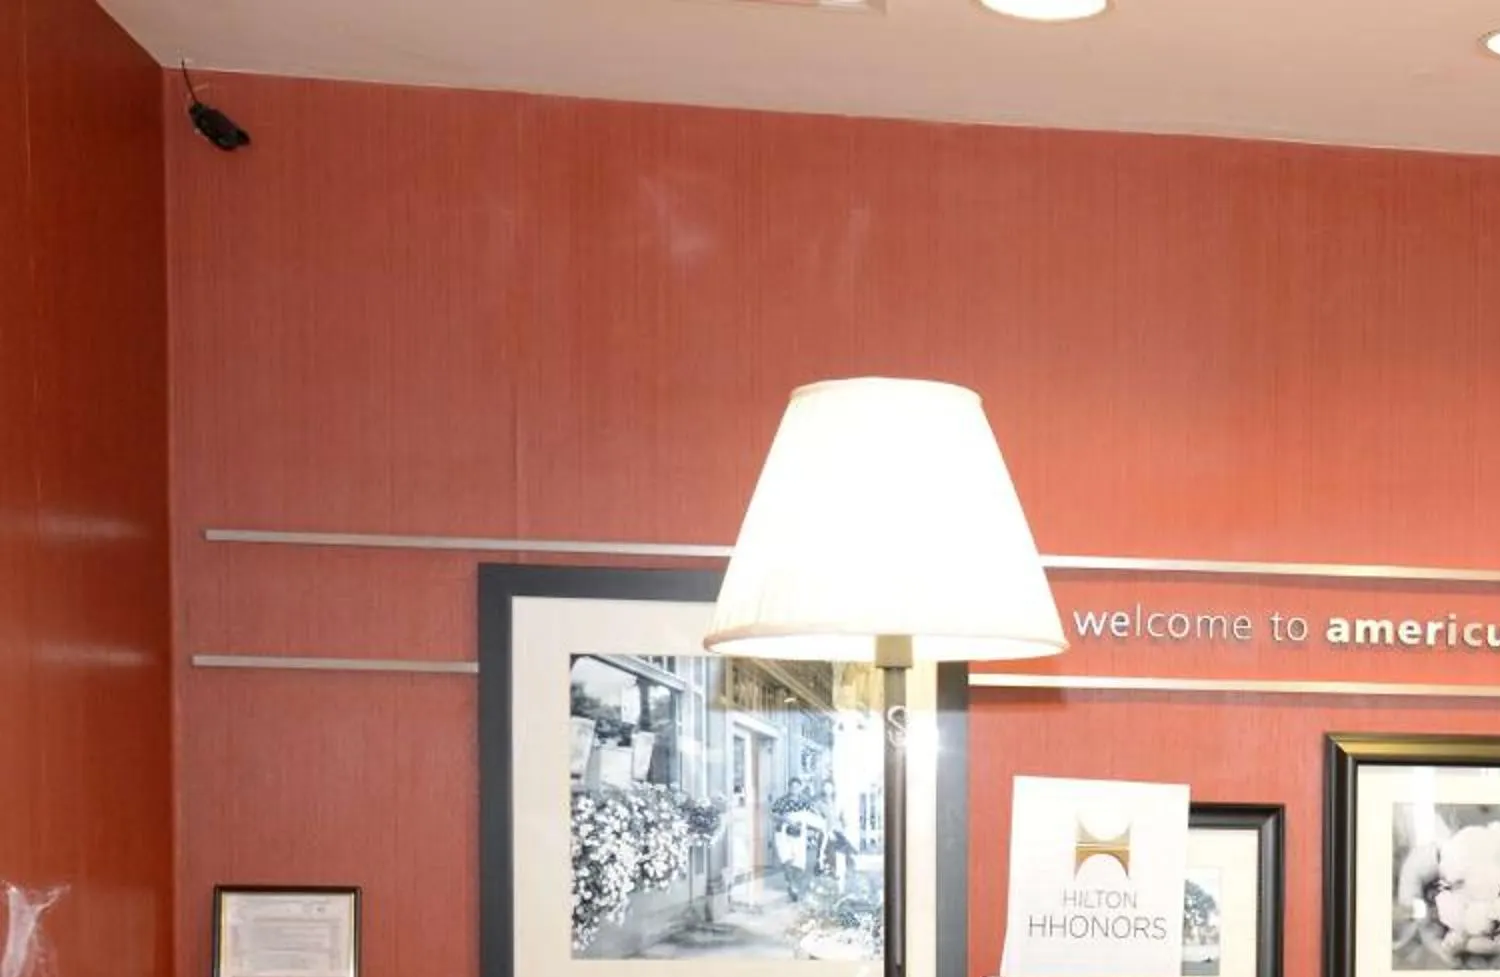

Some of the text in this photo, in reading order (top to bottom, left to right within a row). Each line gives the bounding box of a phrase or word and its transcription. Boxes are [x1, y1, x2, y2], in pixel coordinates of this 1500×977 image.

[1073, 603, 1253, 640] welcome
[1270, 610, 1310, 642] to
[1063, 888, 1138, 909] HILTON
[1028, 914, 1168, 940] HHONORS
